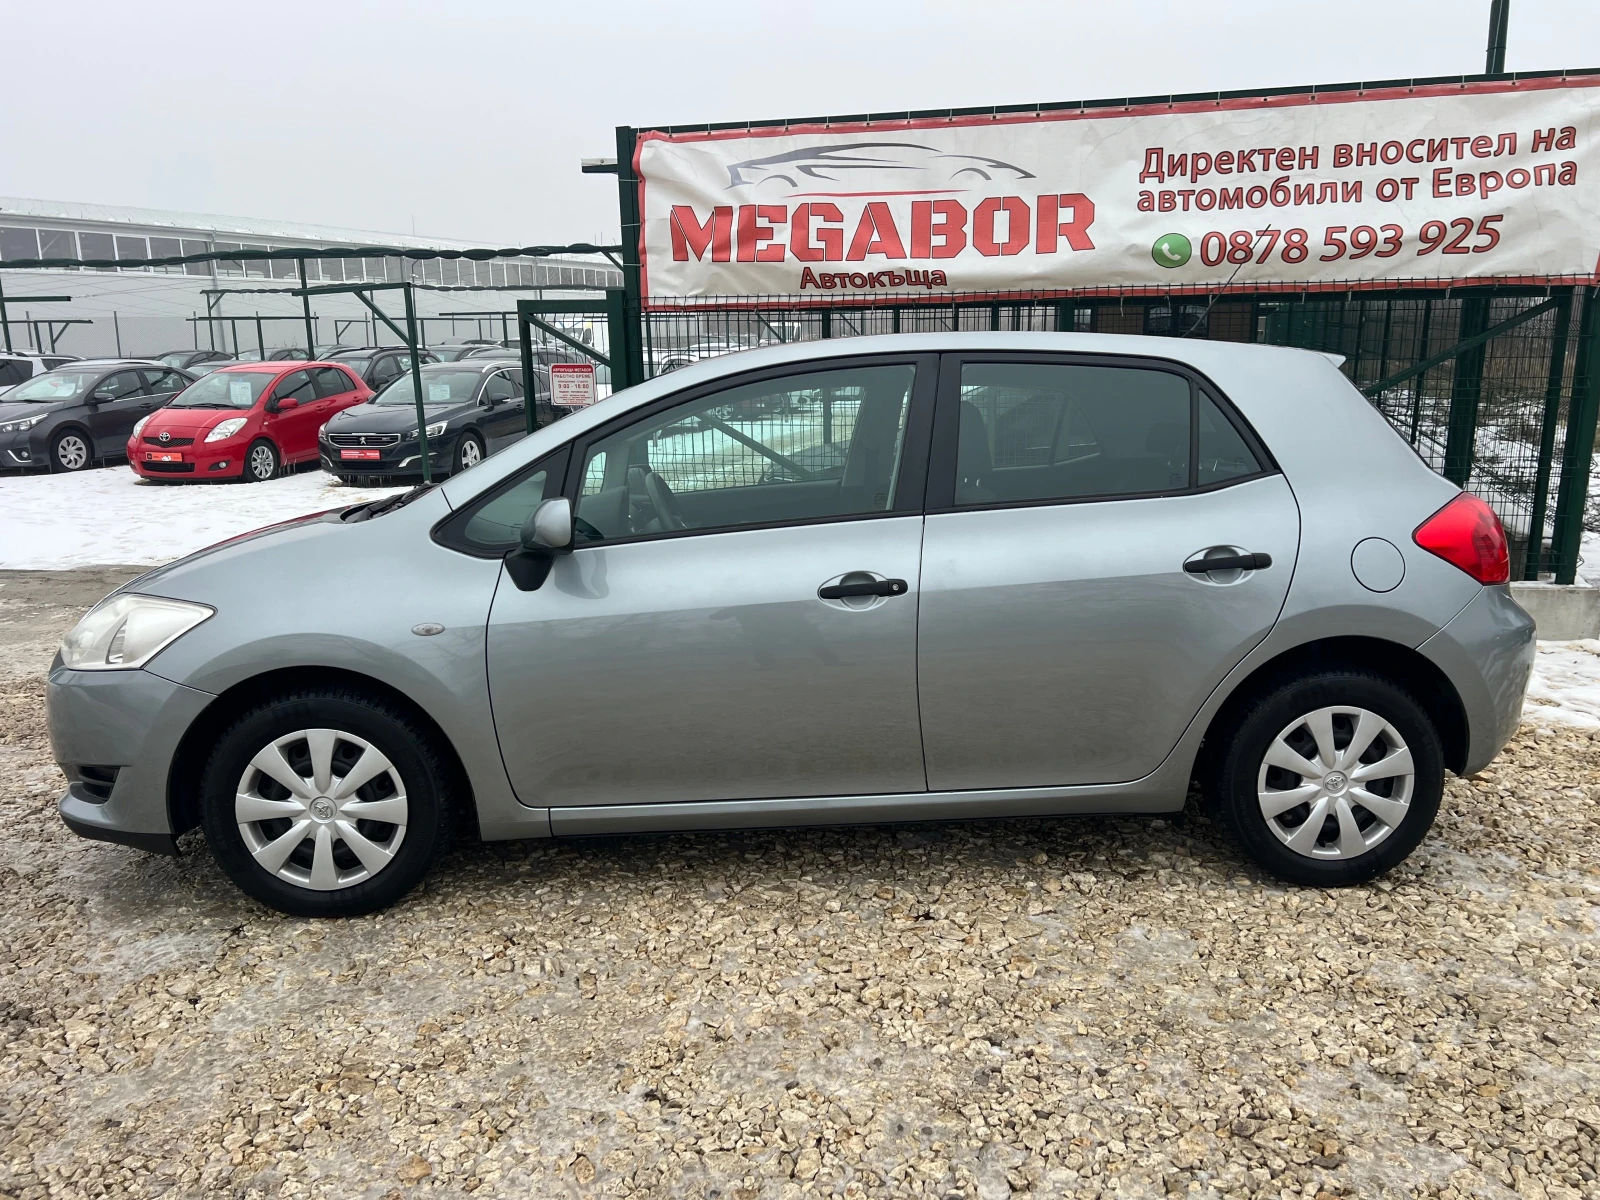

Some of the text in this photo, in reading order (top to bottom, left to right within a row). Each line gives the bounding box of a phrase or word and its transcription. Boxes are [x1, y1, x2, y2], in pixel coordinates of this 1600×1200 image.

[1139, 126, 1577, 183] Директен вносител на
[1136, 160, 1577, 212] автомобили от Европа
[670, 193, 1095, 262] MEGABOR
[1200, 214, 1504, 267] 0878 593 925
[800, 267, 947, 290] Автокъща
